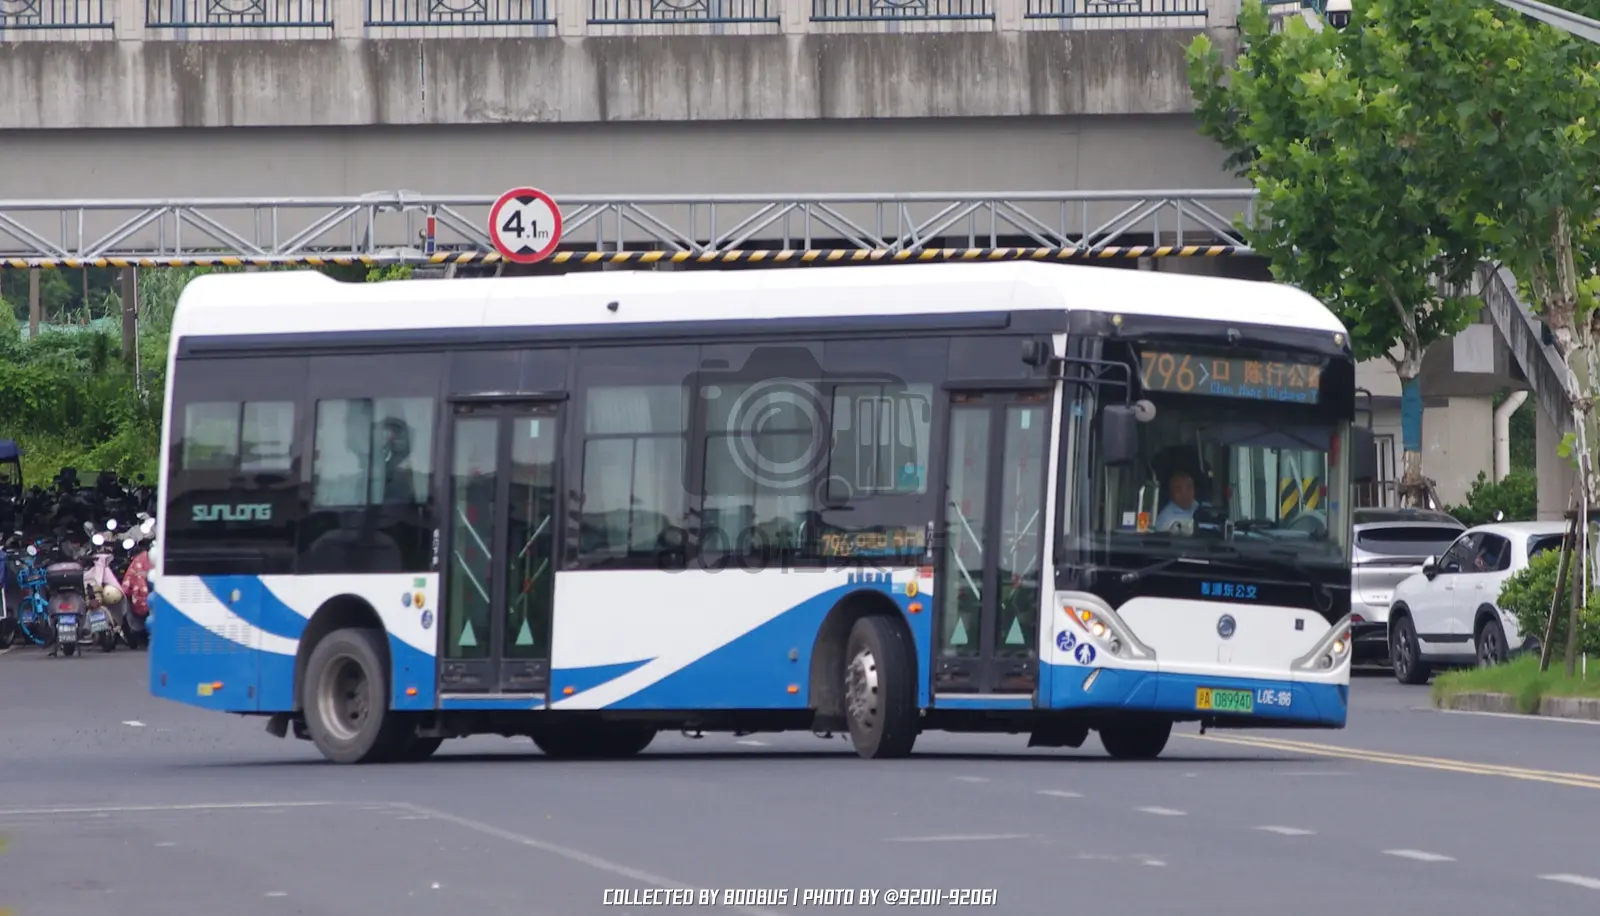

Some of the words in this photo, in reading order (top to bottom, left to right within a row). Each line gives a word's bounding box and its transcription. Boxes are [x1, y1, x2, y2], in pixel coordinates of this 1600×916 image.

[502, 210, 549, 239] 4.1m
[1141, 351, 1195, 391] 796
[192, 504, 271, 521] SUNLONG
